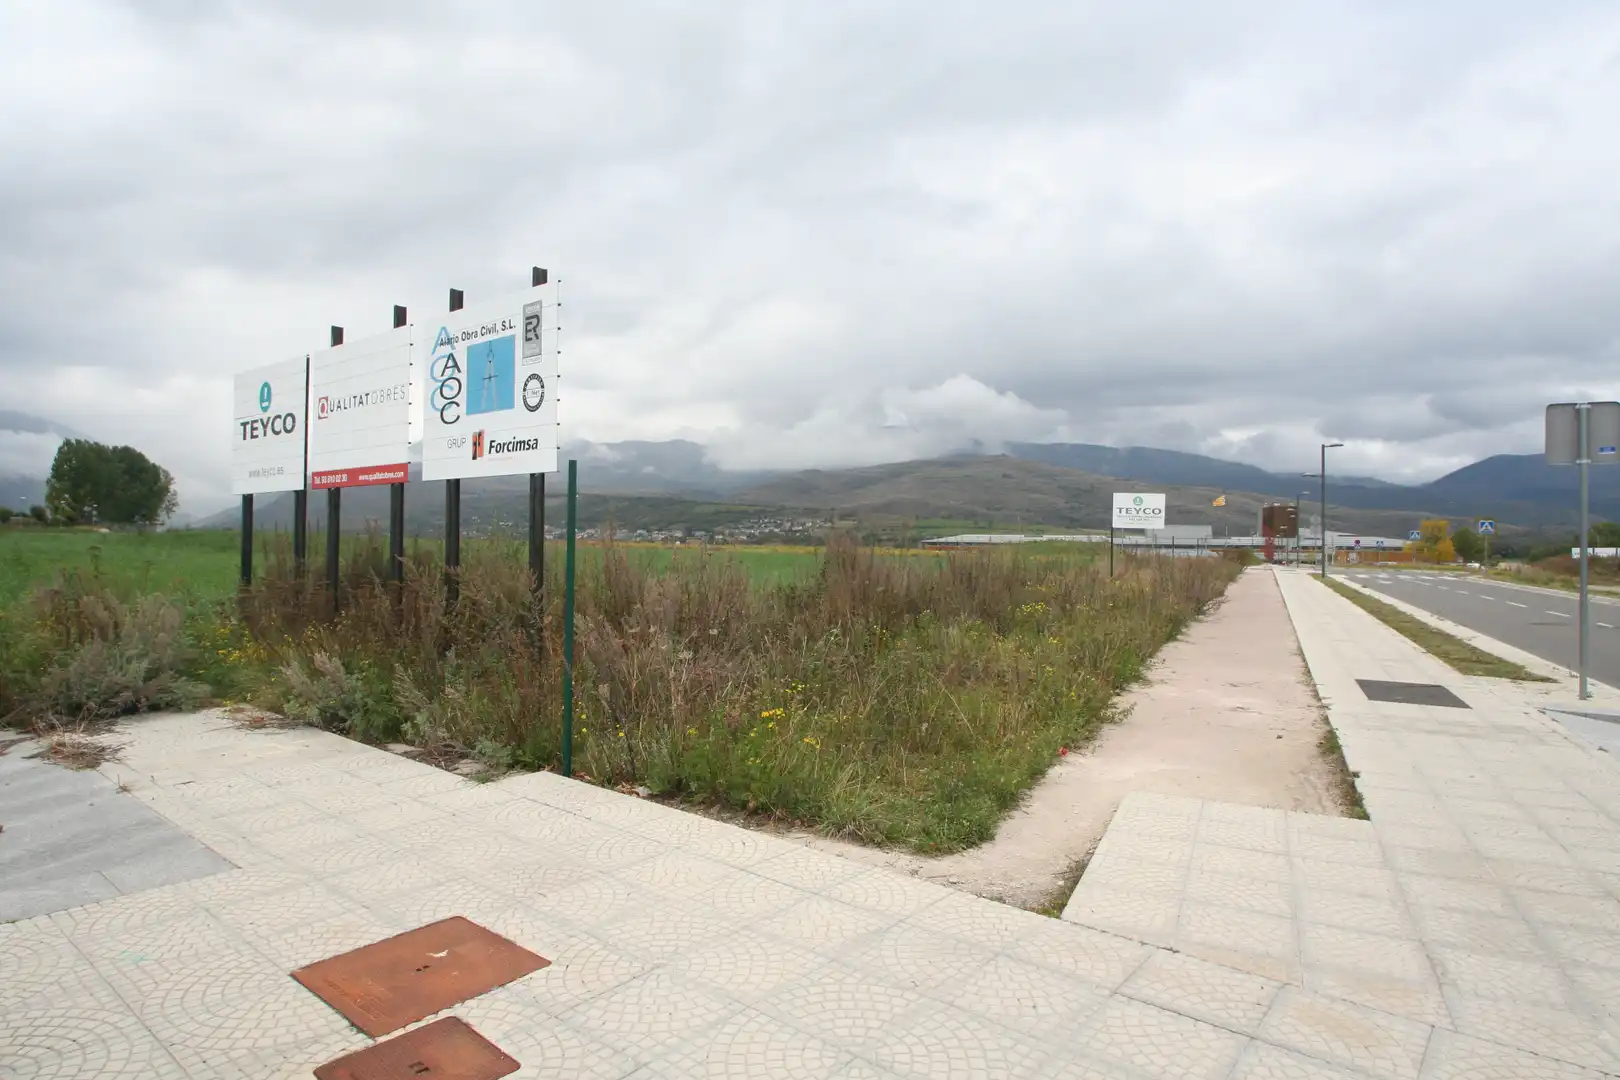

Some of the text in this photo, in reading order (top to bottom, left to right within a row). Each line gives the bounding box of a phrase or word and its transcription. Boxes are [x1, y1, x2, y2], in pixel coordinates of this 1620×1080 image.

[461, 330, 478, 342] Obra
[480, 322, 499, 337] Civil,
[501, 319, 516, 332] S.L.
[240, 412, 296, 441] TEYCO
[447, 436, 539, 455] GRUP Forcimsa
[1116, 507, 1162, 515] TEYCO
